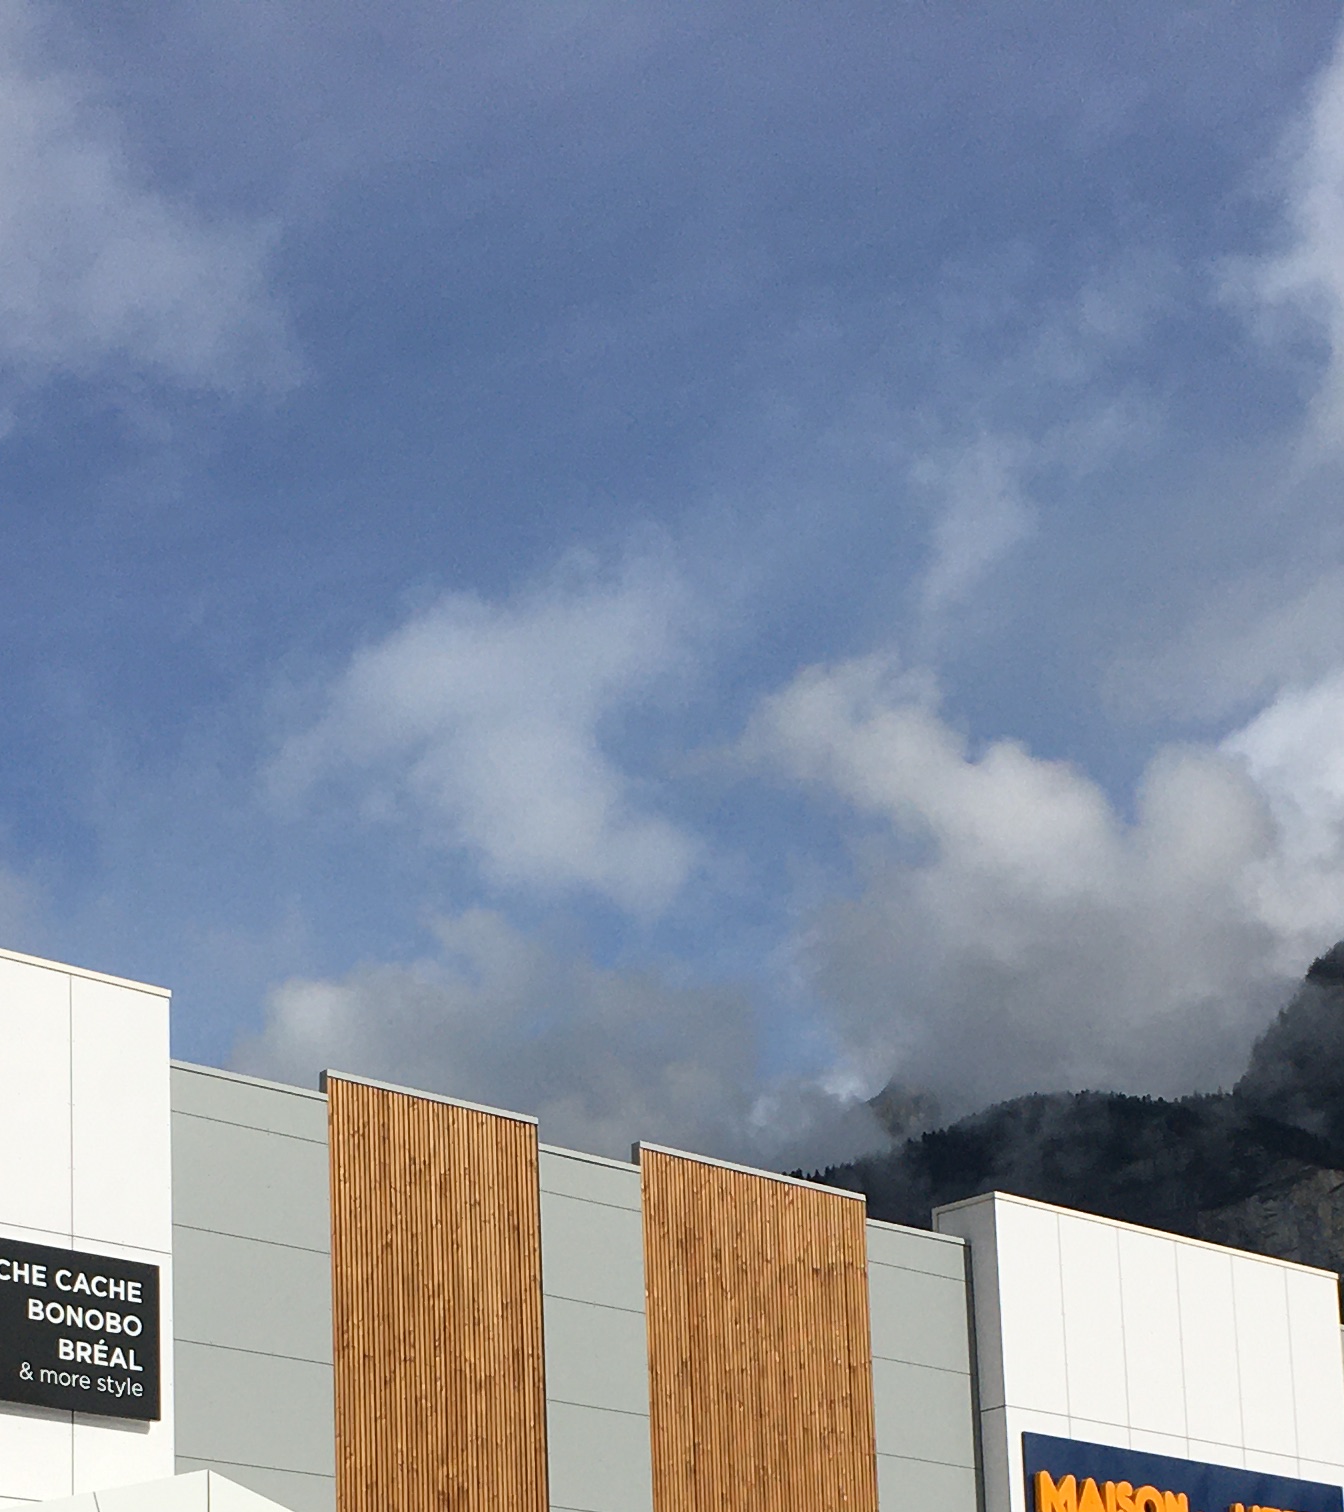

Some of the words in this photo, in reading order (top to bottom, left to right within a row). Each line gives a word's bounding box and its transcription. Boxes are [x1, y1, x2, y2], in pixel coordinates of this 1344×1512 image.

[55, 1269, 143, 1304] CACHE
[27, 1298, 143, 1337] BONOBO
[58, 1338, 144, 1372] BRÉAL
[18, 1361, 34, 1381] &
[39, 1367, 91, 1390] more
[96, 1375, 144, 1398] style
